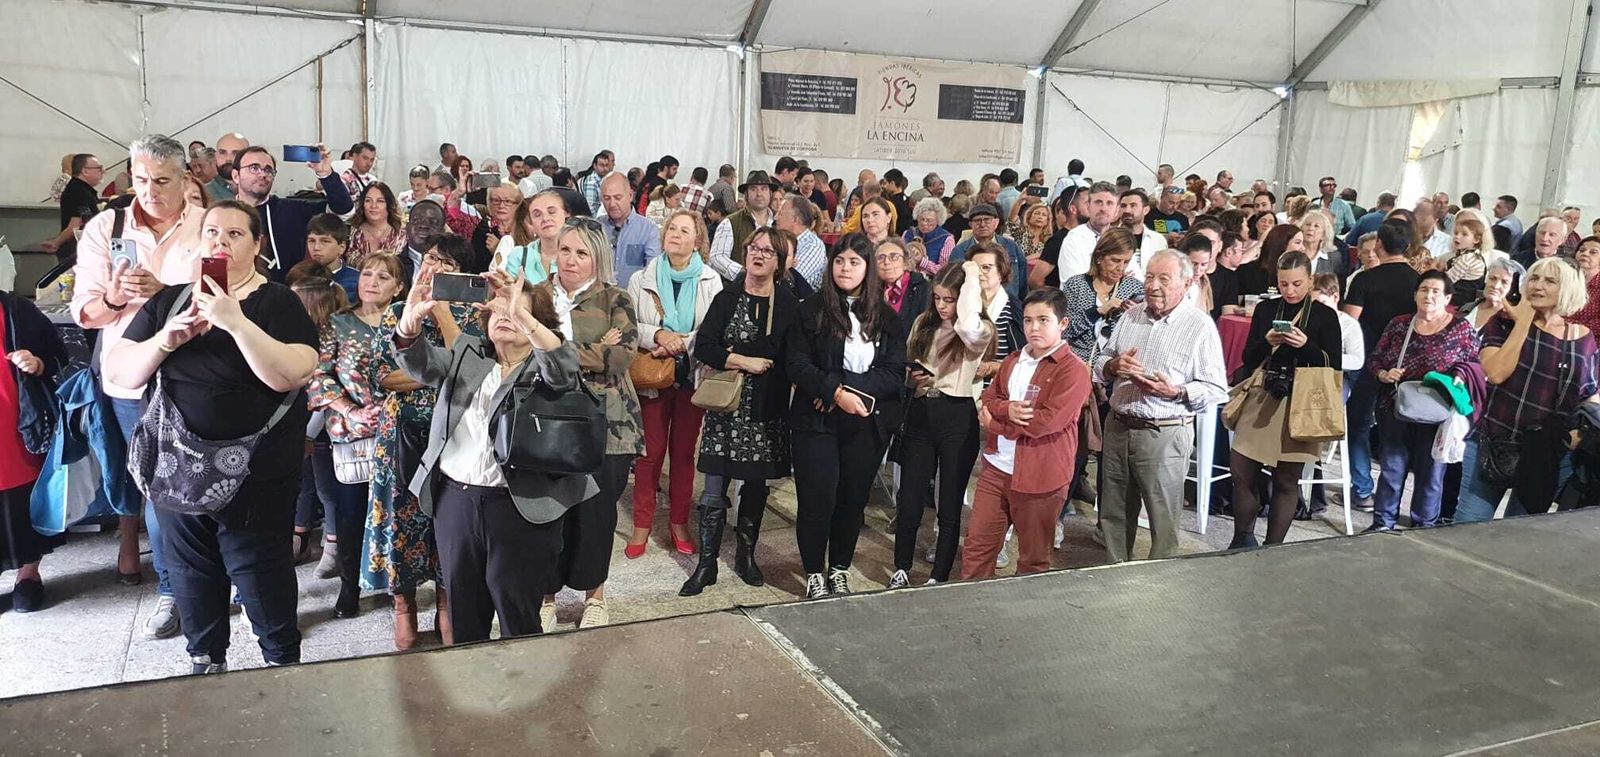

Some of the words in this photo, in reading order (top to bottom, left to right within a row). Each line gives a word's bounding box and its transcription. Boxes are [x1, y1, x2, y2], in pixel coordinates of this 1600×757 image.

[867, 130, 879, 140] LA
[882, 131, 925, 142] ENCINA
[173, 439, 204, 459] Desigual
